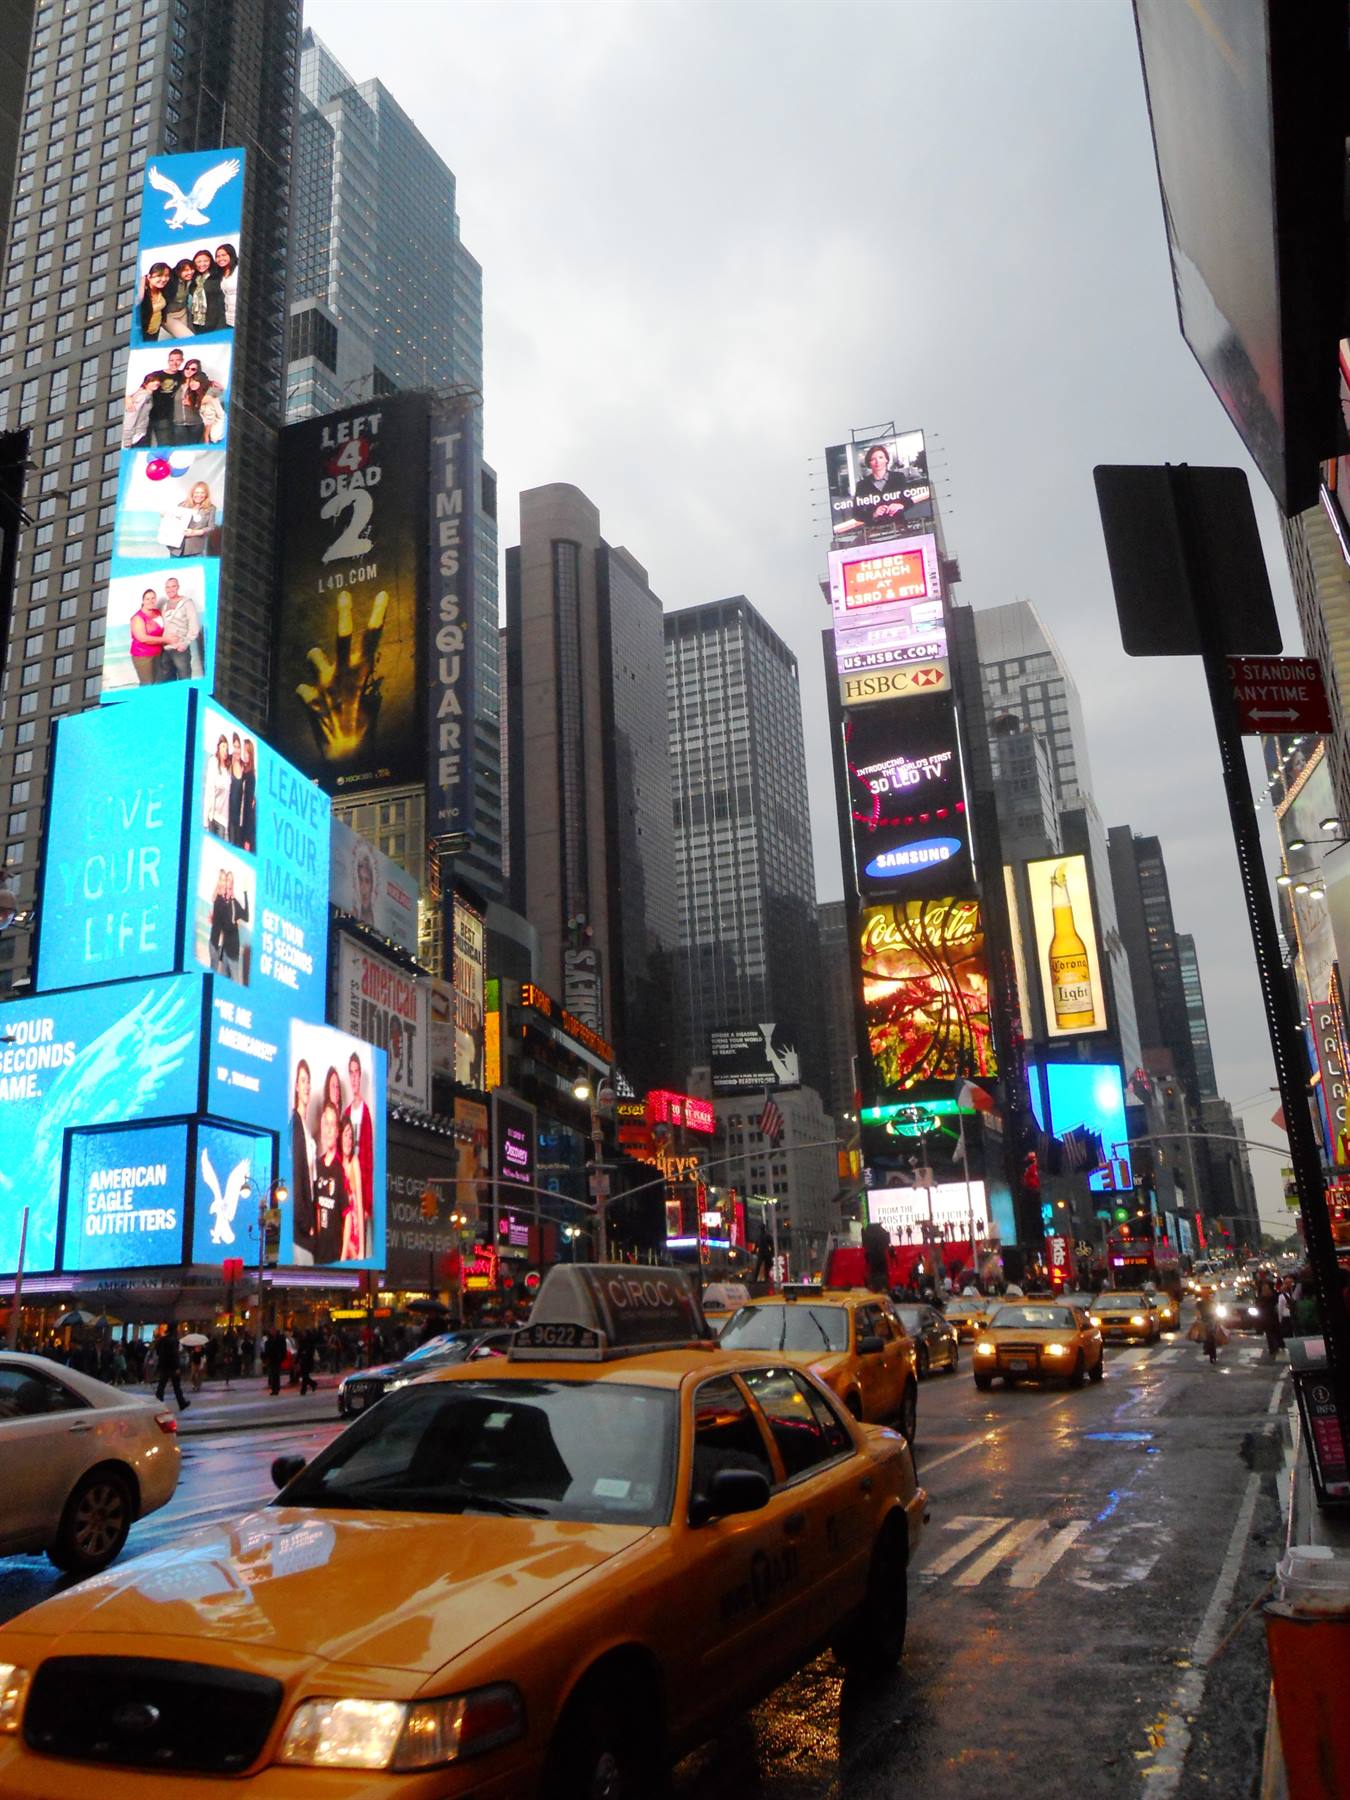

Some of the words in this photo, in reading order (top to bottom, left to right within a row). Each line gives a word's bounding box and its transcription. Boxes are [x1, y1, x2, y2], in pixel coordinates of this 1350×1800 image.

[321, 412, 383, 449] LEFT
[337, 439, 362, 470] 4
[320, 466, 382, 498] DEAD
[435, 432, 463, 577] TIMES
[833, 499, 854, 510] can
[856, 494, 881, 506] help
[882, 490, 901, 501] our
[903, 486, 930, 497] com
[320, 488, 374, 566] 2
[317, 563, 377, 593] L4D.COM
[856, 564, 910, 583] BRANCH
[876, 579, 892, 588] AT
[846, 591, 881, 606] 53RD
[844, 644, 939, 669] US.HSBC.COM
[1243, 665, 1315, 680] STANDING
[435, 593, 465, 786] SQUARE
[846, 673, 909, 698] HSBC
[1233, 686, 1309, 701] ANYTIME
[856, 757, 905, 777] INTRODUCING
[881, 767, 896, 777] THE
[928, 751, 952, 764] FIRST
[869, 778, 890, 794] 3D
[891, 769, 920, 788] LED
[922, 763, 942, 780] TV
[268, 759, 319, 830] LEAVE
[438, 807, 460, 819] NYC
[273, 811, 317, 876] YOUR
[876, 846, 950, 868] SAMSUNG
[262, 909, 279, 934] GET
[281, 917, 305, 949] YOUR
[260, 953, 273, 976] OF
[261, 931, 274, 952] 15
[274, 937, 313, 976] SECONDS
[1053, 959, 1088, 973] Corona
[1057, 986, 1088, 1002] Light
[0, 1041, 76, 1073] ECONDS
[89, 1164, 167, 1191] AMERICAN
[87, 1188, 134, 1213] EAGLE
[85, 1208, 177, 1236] OUTFITTERS
[534, 1326, 576, 1345] 9G22
[1315, 1405, 1336, 1414] INFO
